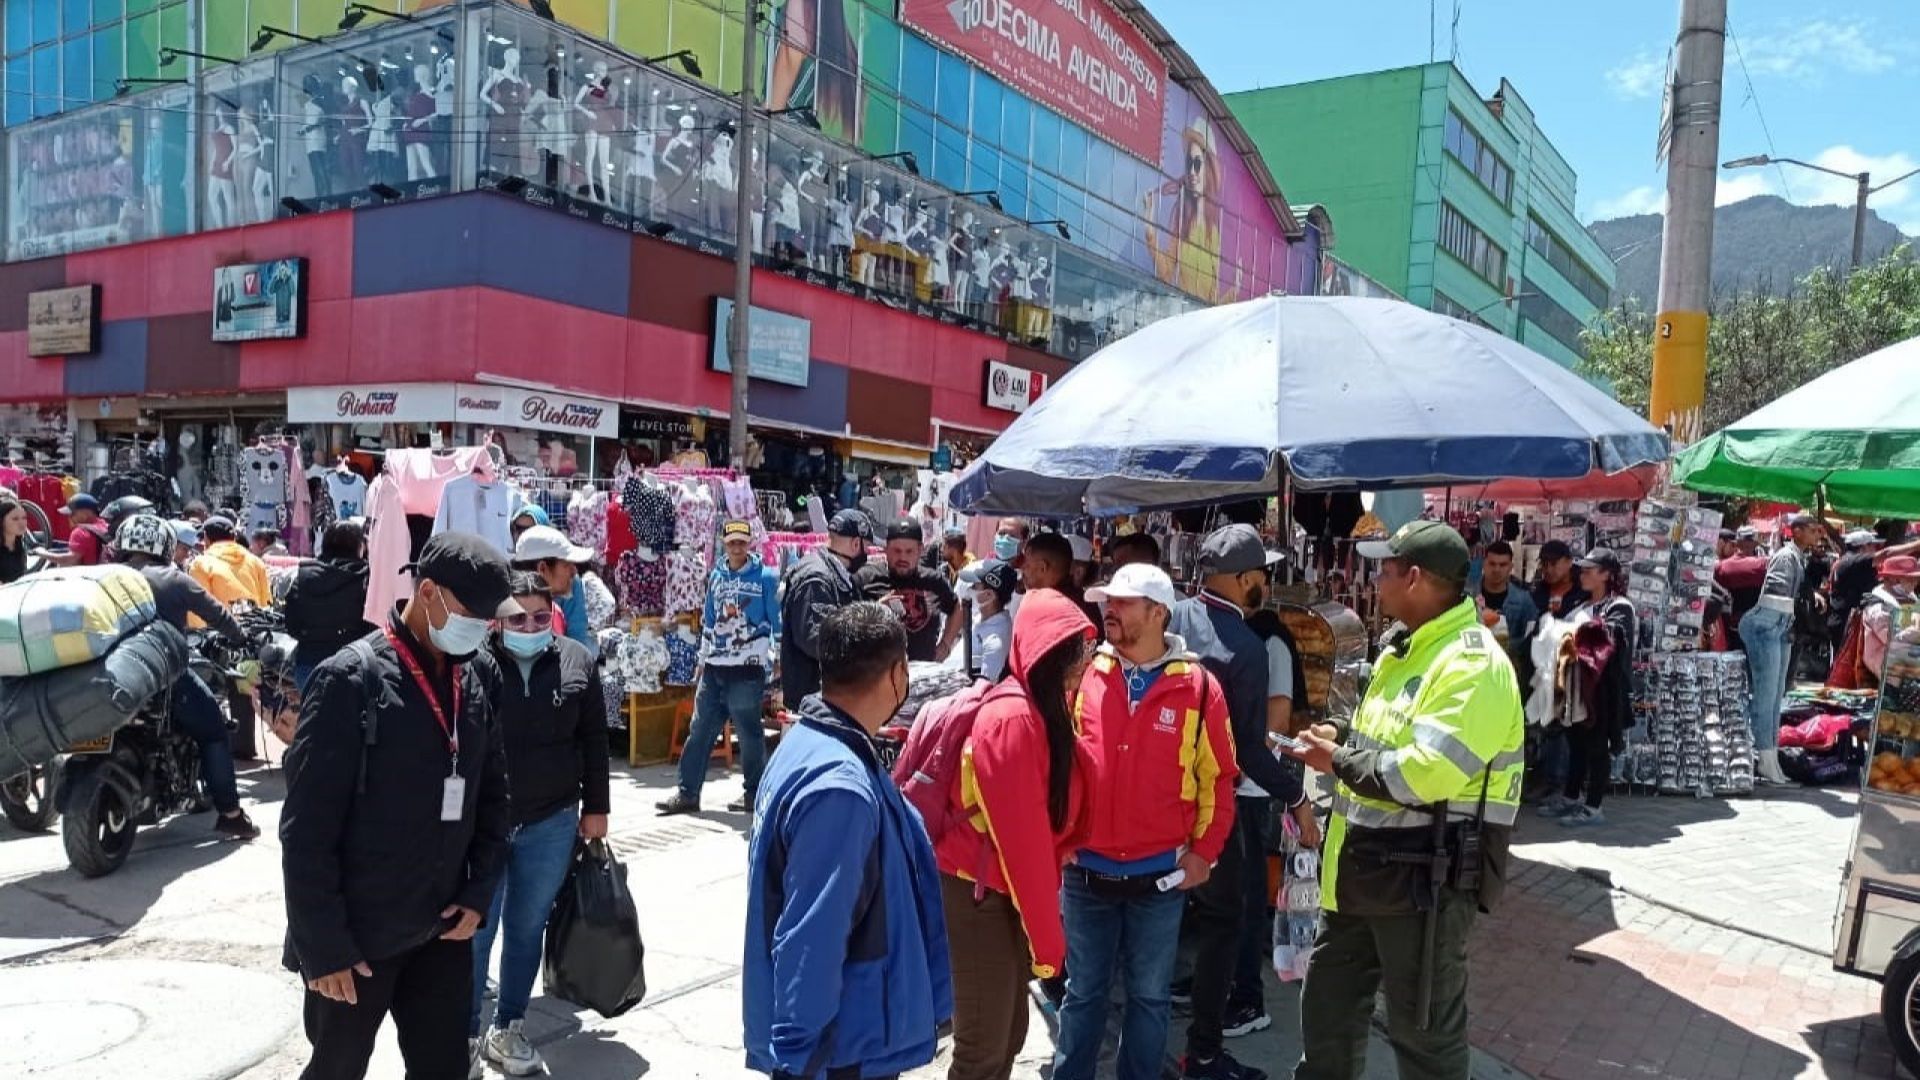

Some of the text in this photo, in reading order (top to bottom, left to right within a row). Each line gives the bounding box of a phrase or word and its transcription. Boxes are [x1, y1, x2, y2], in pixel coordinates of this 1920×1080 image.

[982, 0, 1138, 118] DECIMA AVENIDA
[1090, 8, 1158, 101] MAYORISTA
[337, 391, 397, 417] Richard
[521, 396, 603, 430] Richard
[632, 419, 665, 432] LEVEL
